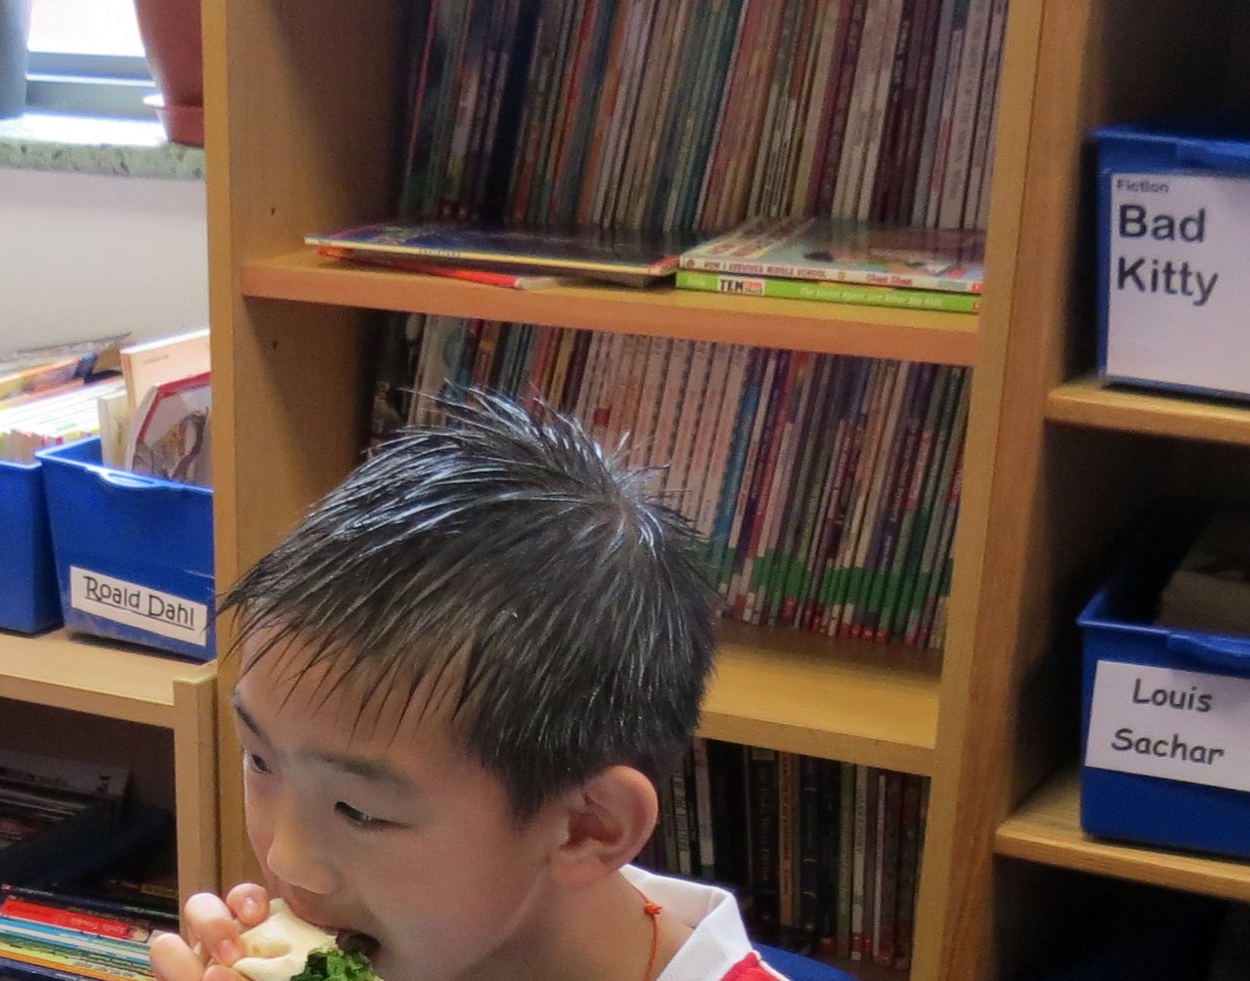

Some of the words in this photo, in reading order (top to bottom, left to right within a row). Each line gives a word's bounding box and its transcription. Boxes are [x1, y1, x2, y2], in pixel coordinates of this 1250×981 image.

[1116, 179, 1170, 193] Fiction
[1118, 204, 1206, 243] Bad
[1116, 256, 1220, 306] Kitty
[83, 575, 140, 609] Roald
[148, 594, 194, 626] Dahl
[1132, 678, 1212, 712] Louis
[1111, 728, 1224, 765] Sachar
